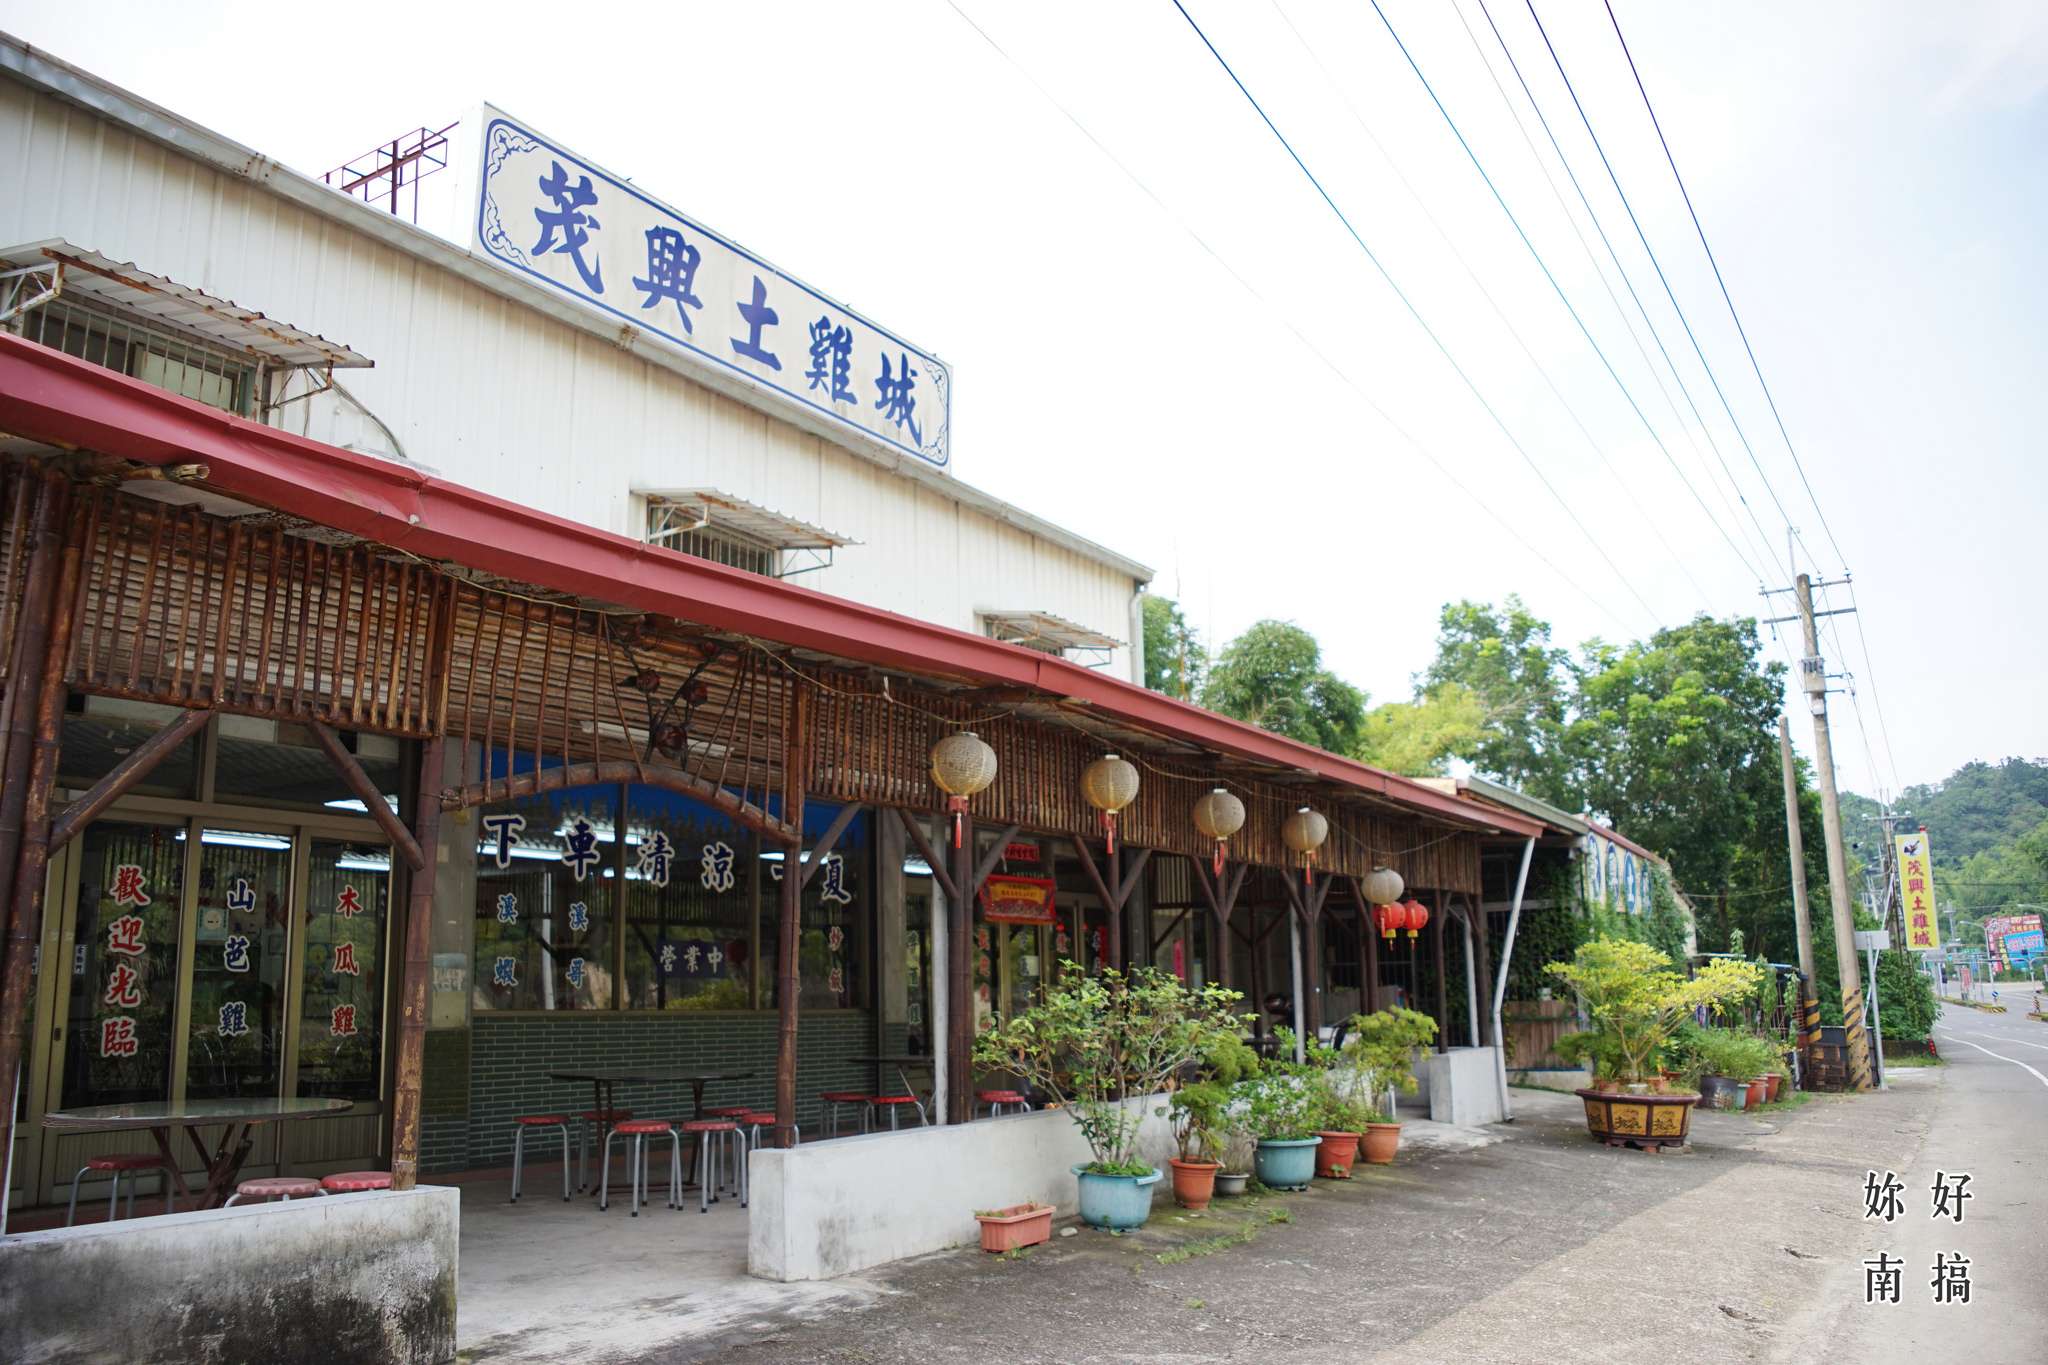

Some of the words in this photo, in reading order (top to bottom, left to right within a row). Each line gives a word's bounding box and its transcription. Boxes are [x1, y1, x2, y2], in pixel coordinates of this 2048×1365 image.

[531, 160, 922, 447] 茂興土雞城
[101, 865, 151, 1057] 歡迎光臨
[218, 878, 256, 1036] 山芭雞
[331, 885, 363, 1037] 木瓜雞
[566, 901, 589, 989] 溪哥
[660, 944, 723, 973] 營業中
